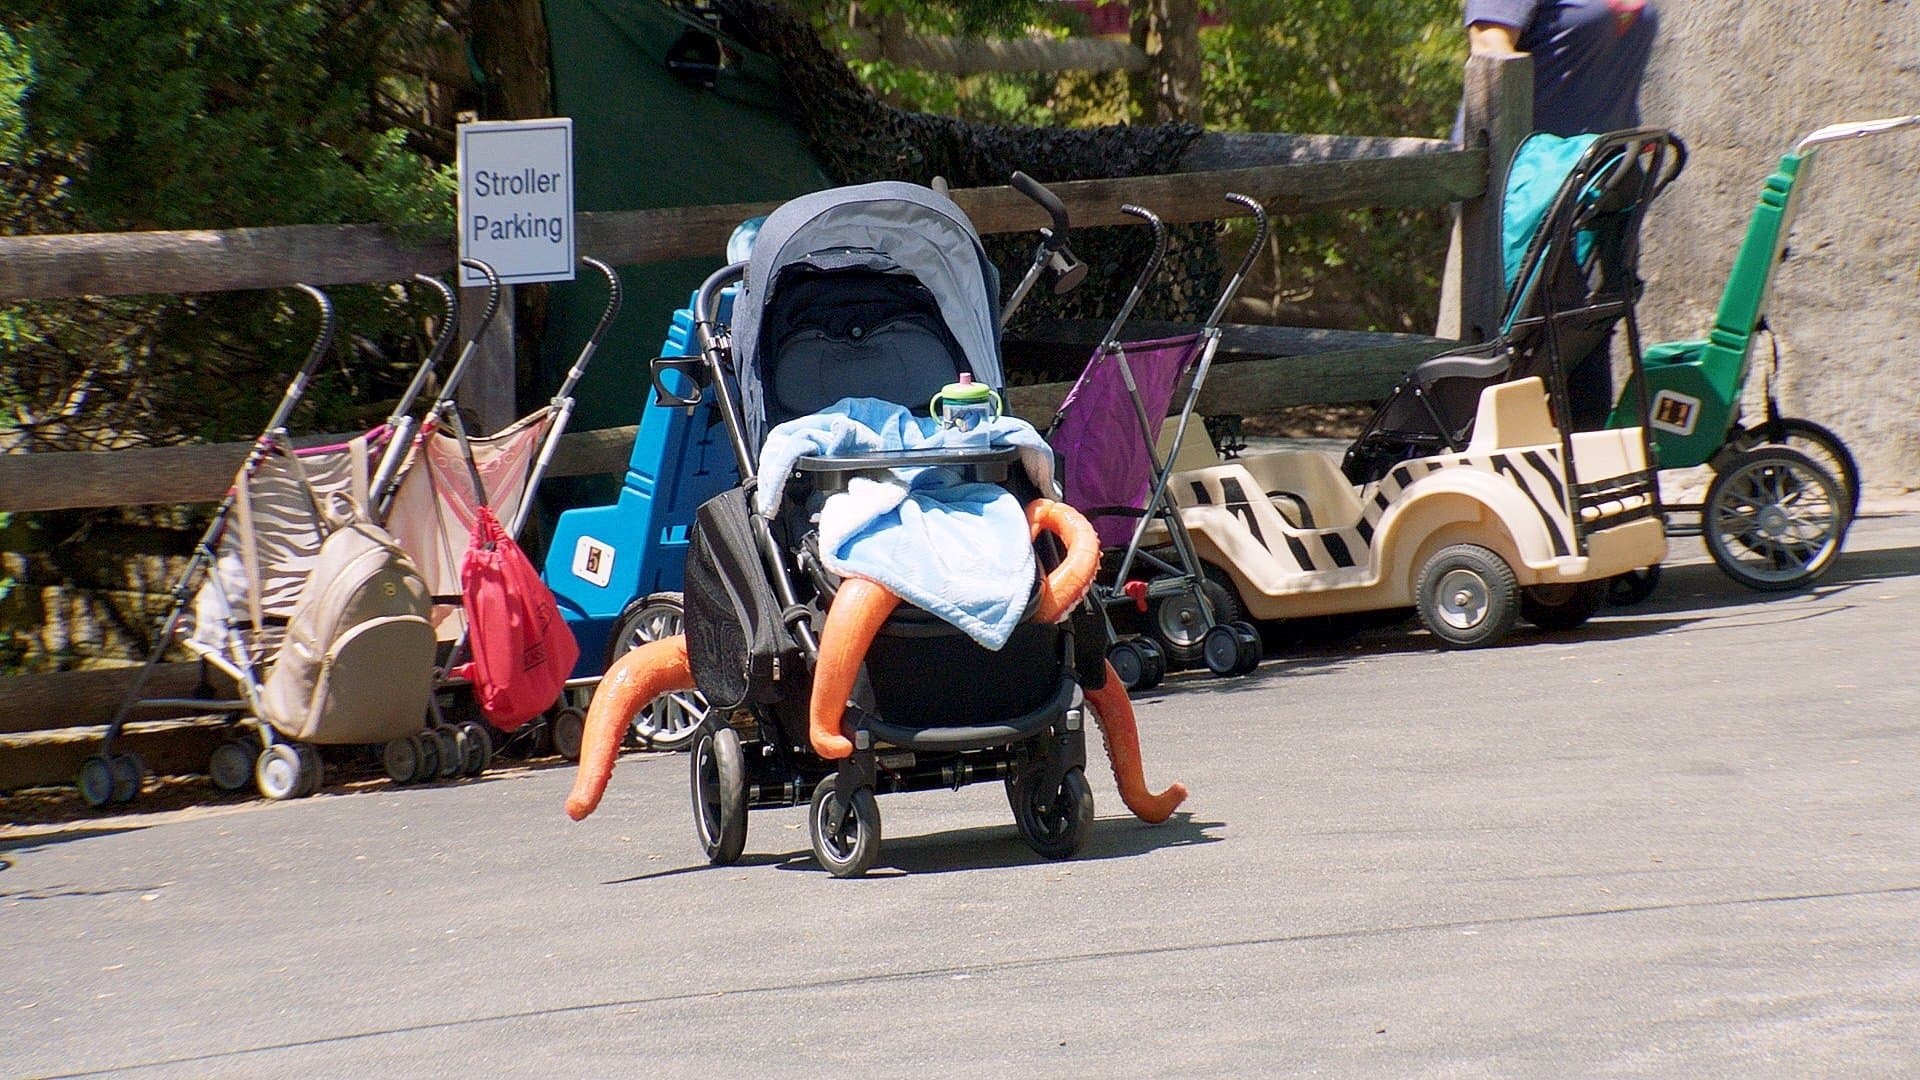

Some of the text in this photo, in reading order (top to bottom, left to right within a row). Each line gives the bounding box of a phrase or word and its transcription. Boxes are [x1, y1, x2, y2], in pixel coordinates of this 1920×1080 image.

[475, 168, 560, 197] Stroller
[474, 212, 562, 243] Parking
[588, 547, 600, 573] 5
